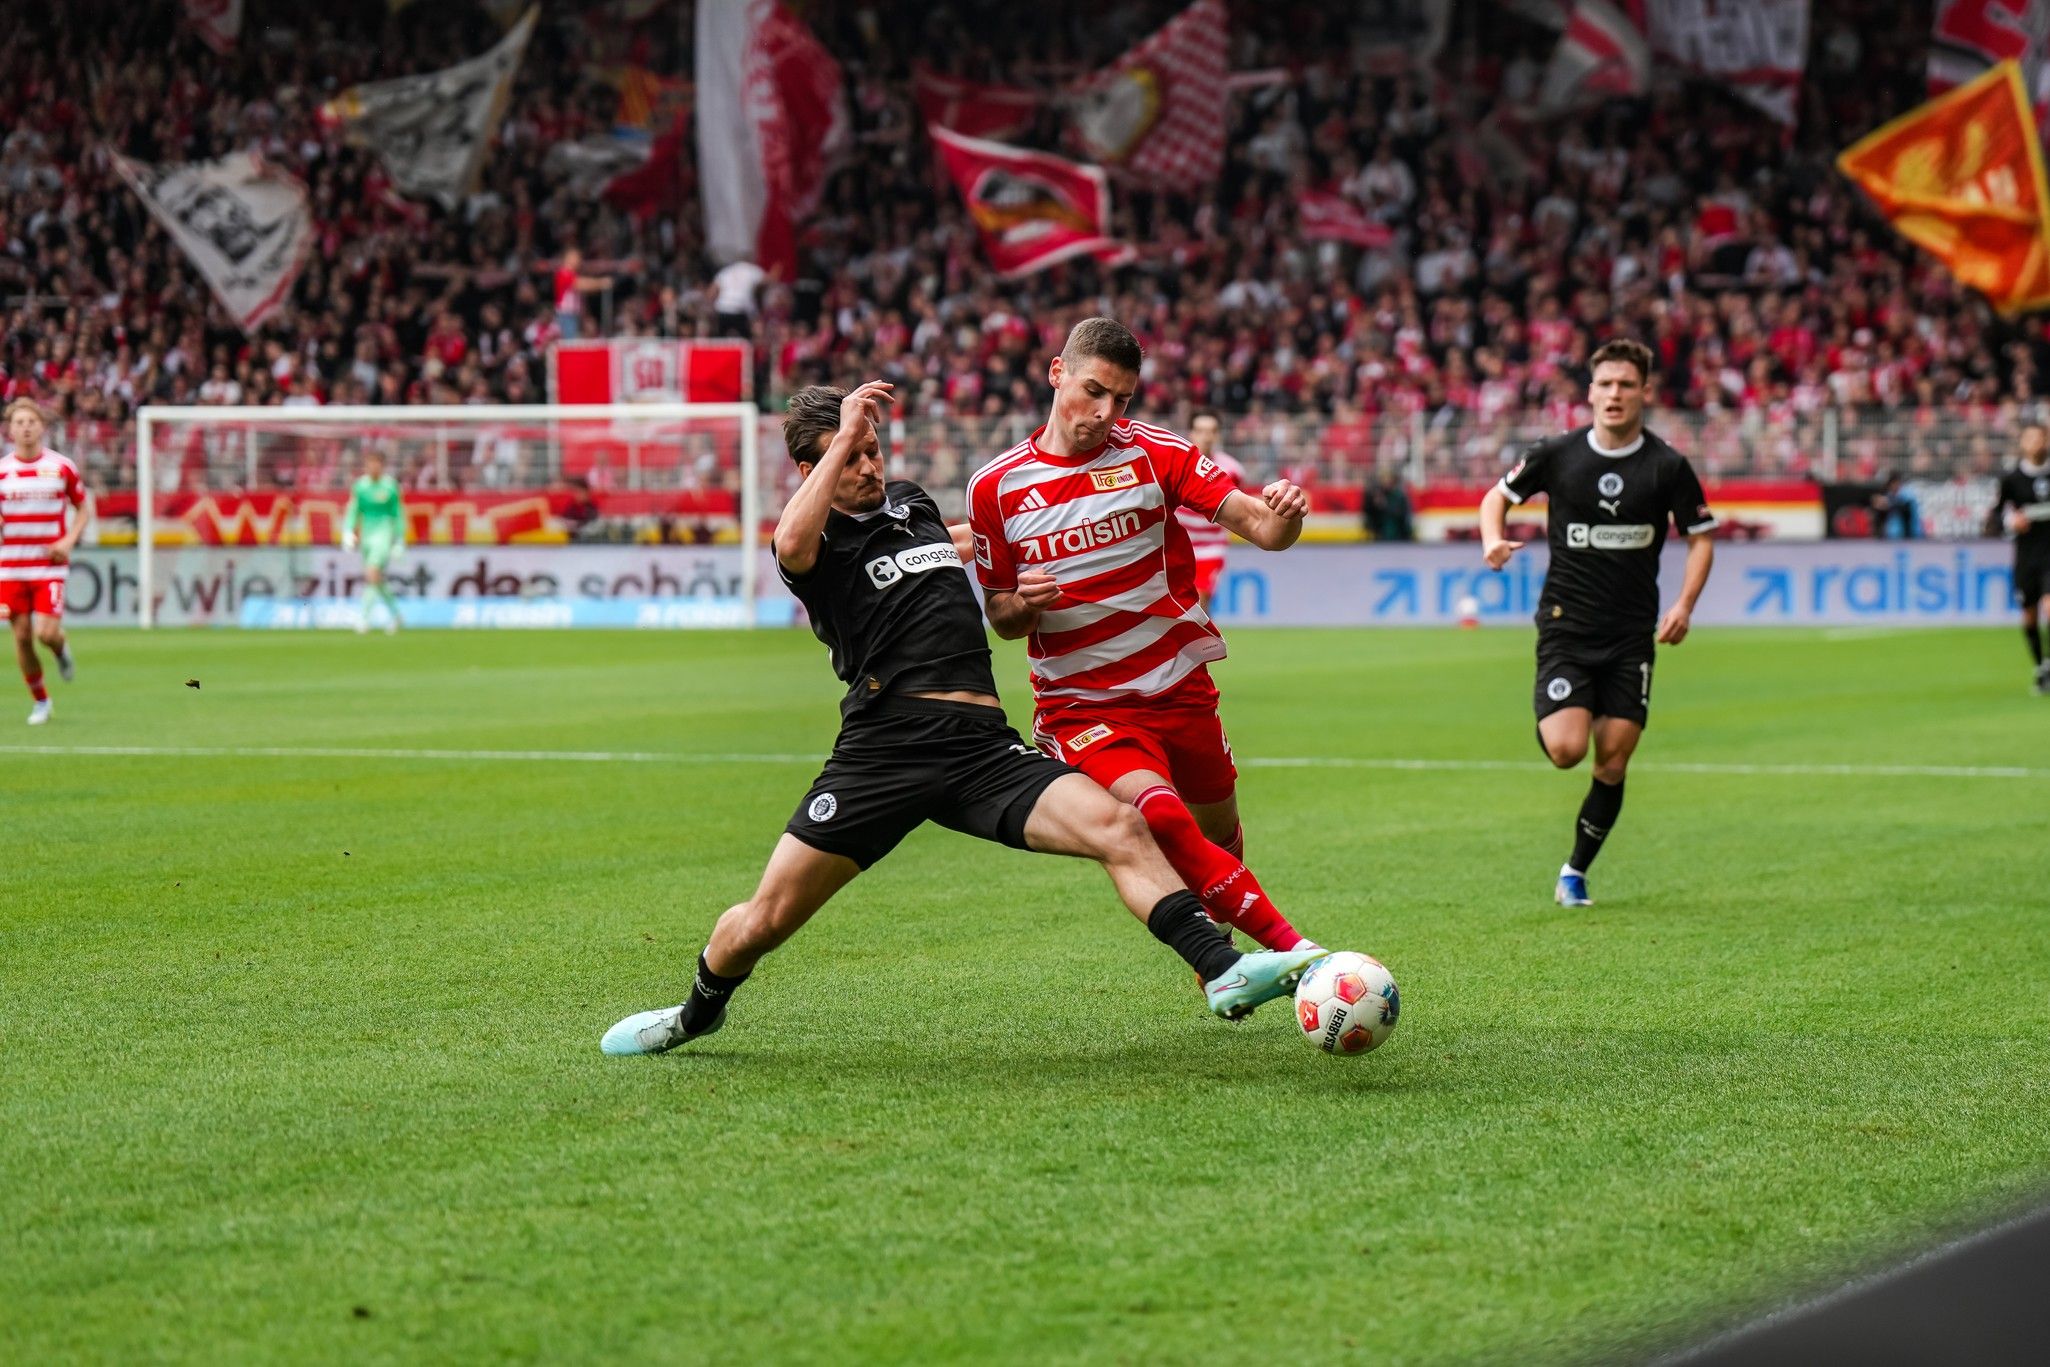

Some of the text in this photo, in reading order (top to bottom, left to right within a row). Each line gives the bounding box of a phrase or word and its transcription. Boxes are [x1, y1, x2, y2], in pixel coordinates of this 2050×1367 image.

[1047, 511, 1140, 557] raisin
[172, 559, 276, 613] wie
[1812, 550, 2020, 614] raisin
